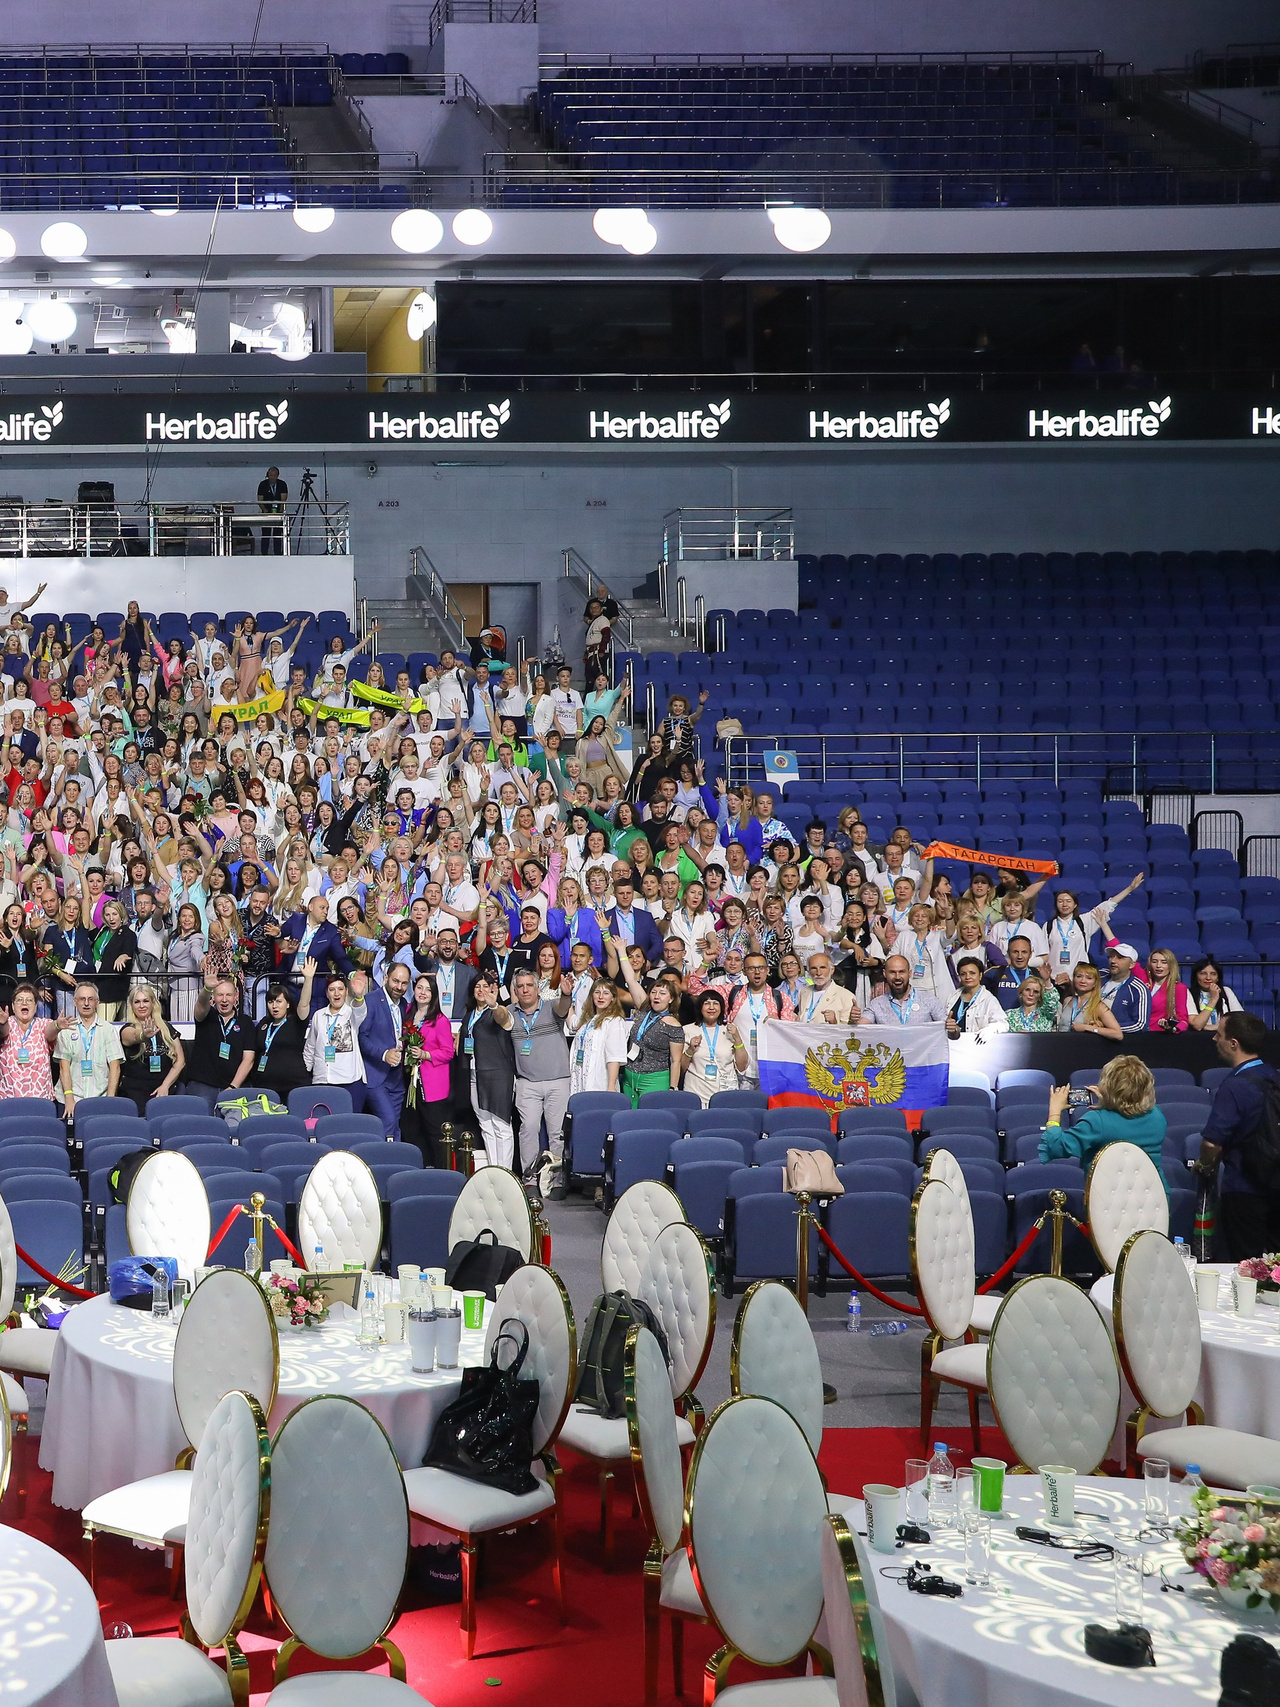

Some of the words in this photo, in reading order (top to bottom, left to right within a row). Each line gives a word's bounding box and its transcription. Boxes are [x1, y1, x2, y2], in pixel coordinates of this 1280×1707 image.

[146, 412, 276, 440] Herbalife
[369, 411, 499, 439] Herbalife
[590, 411, 720, 439] Herbalife
[810, 410, 939, 439] Herbalife
[1029, 408, 1159, 438] Herbalife
[326, 709, 353, 720] УРАЛ
[637, 746, 646, 755] 11
[951, 847, 1036, 871] ТАТАРСТАН
[1048, 1478, 1060, 1518] Herbalife
[866, 1502, 875, 1544] Herbalife
[430, 1570, 456, 1582] Herbalife
